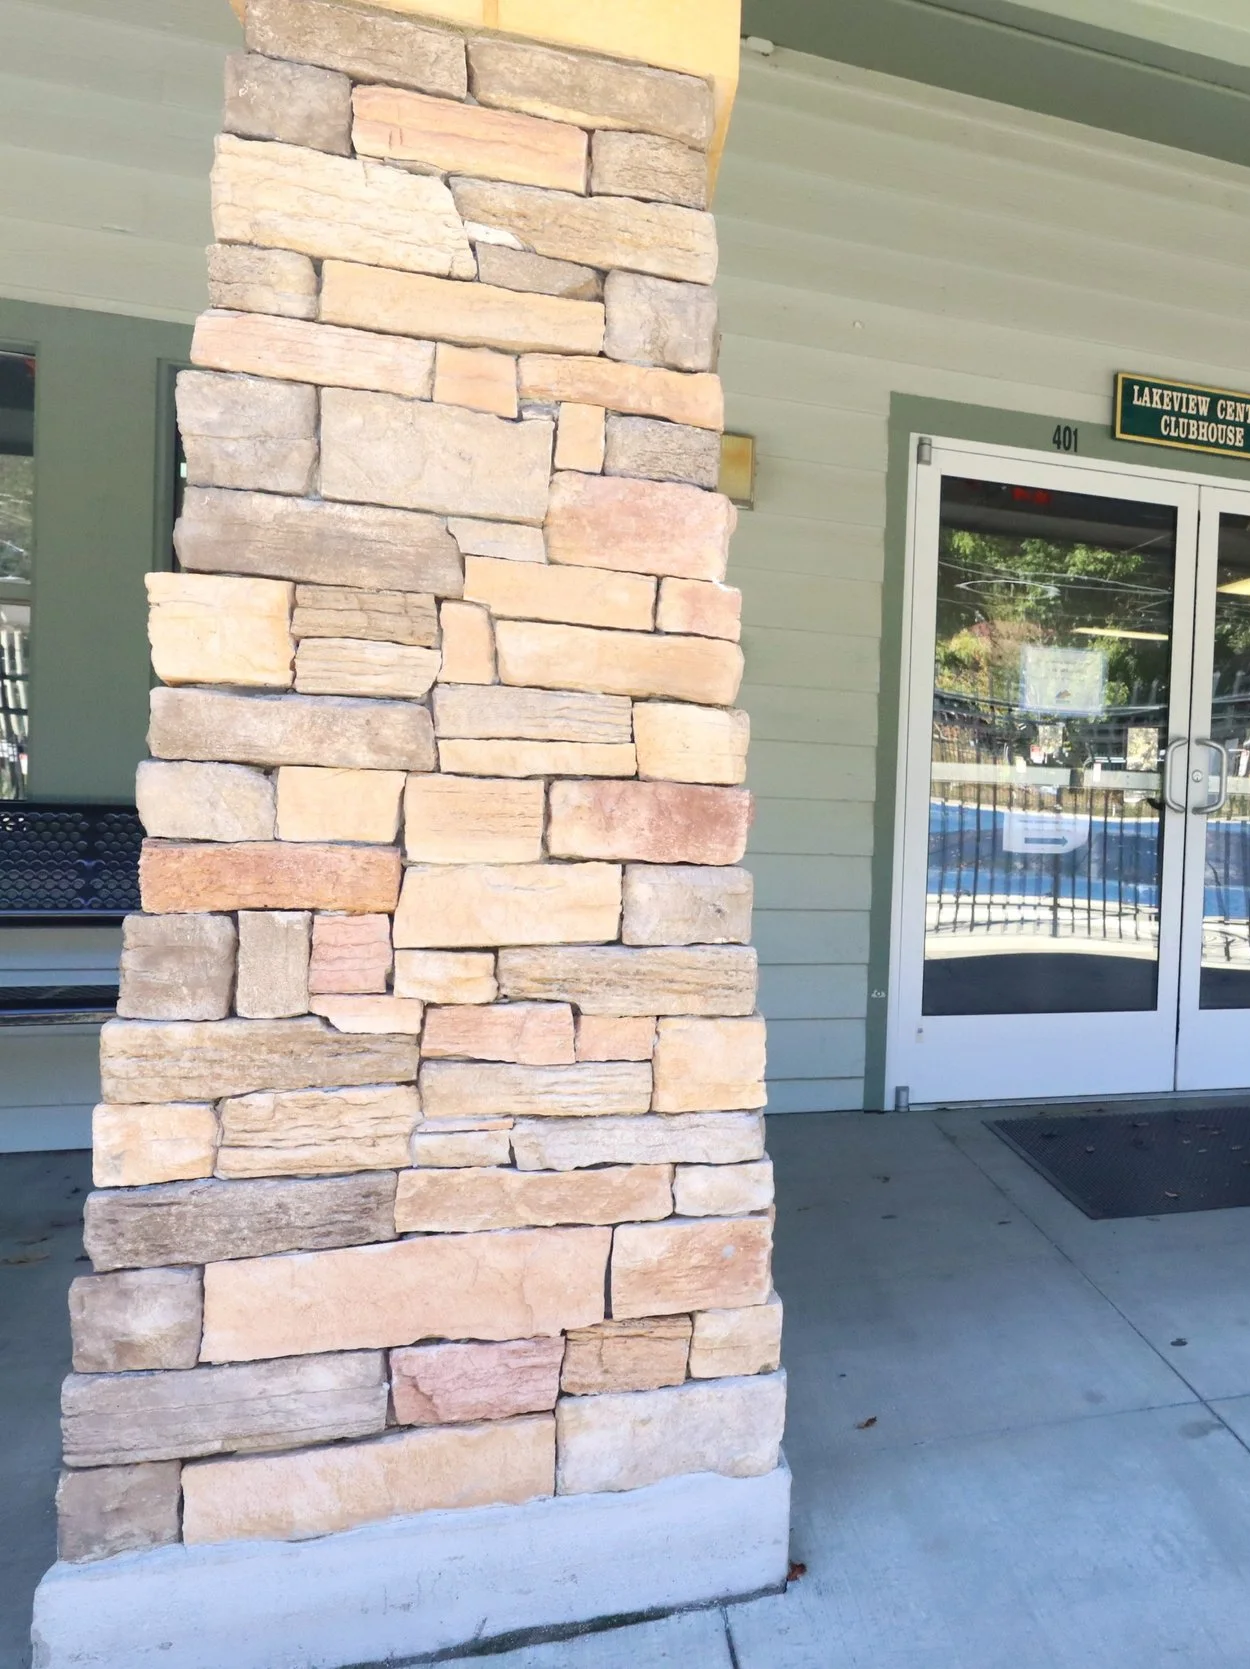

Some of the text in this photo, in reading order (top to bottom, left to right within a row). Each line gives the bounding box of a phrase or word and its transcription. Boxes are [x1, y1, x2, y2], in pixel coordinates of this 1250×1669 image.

[1132, 385, 1211, 417] LAKEVIEW
[1052, 424, 1078, 453] 401
[1160, 415, 1244, 447] CLUBHOUSE
